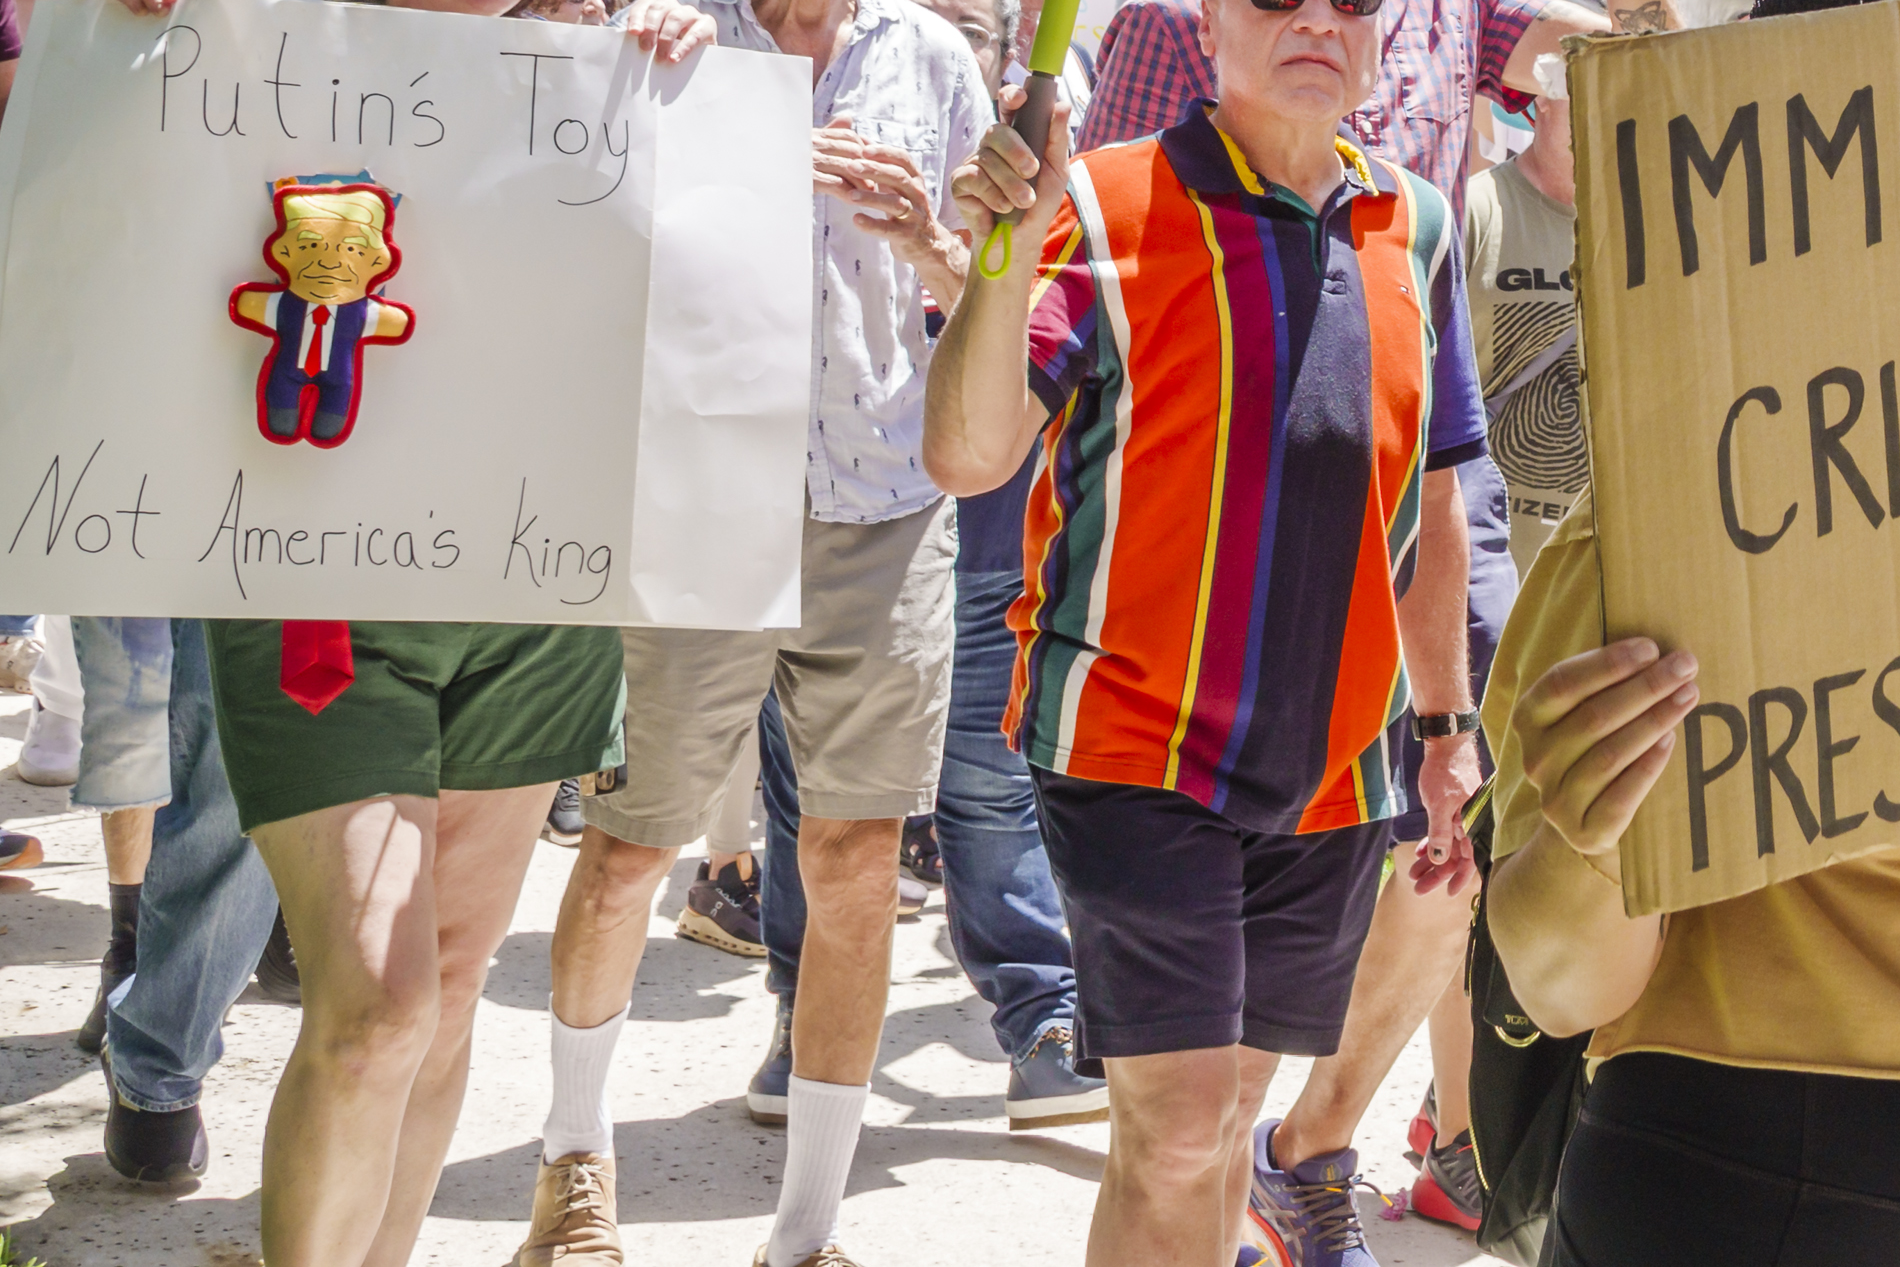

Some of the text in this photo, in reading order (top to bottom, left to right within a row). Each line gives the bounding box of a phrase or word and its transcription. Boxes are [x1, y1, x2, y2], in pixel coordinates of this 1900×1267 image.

[155, 24, 631, 205] Putin's Toy
[8, 440, 161, 558] Not
[198, 468, 461, 600] America's
